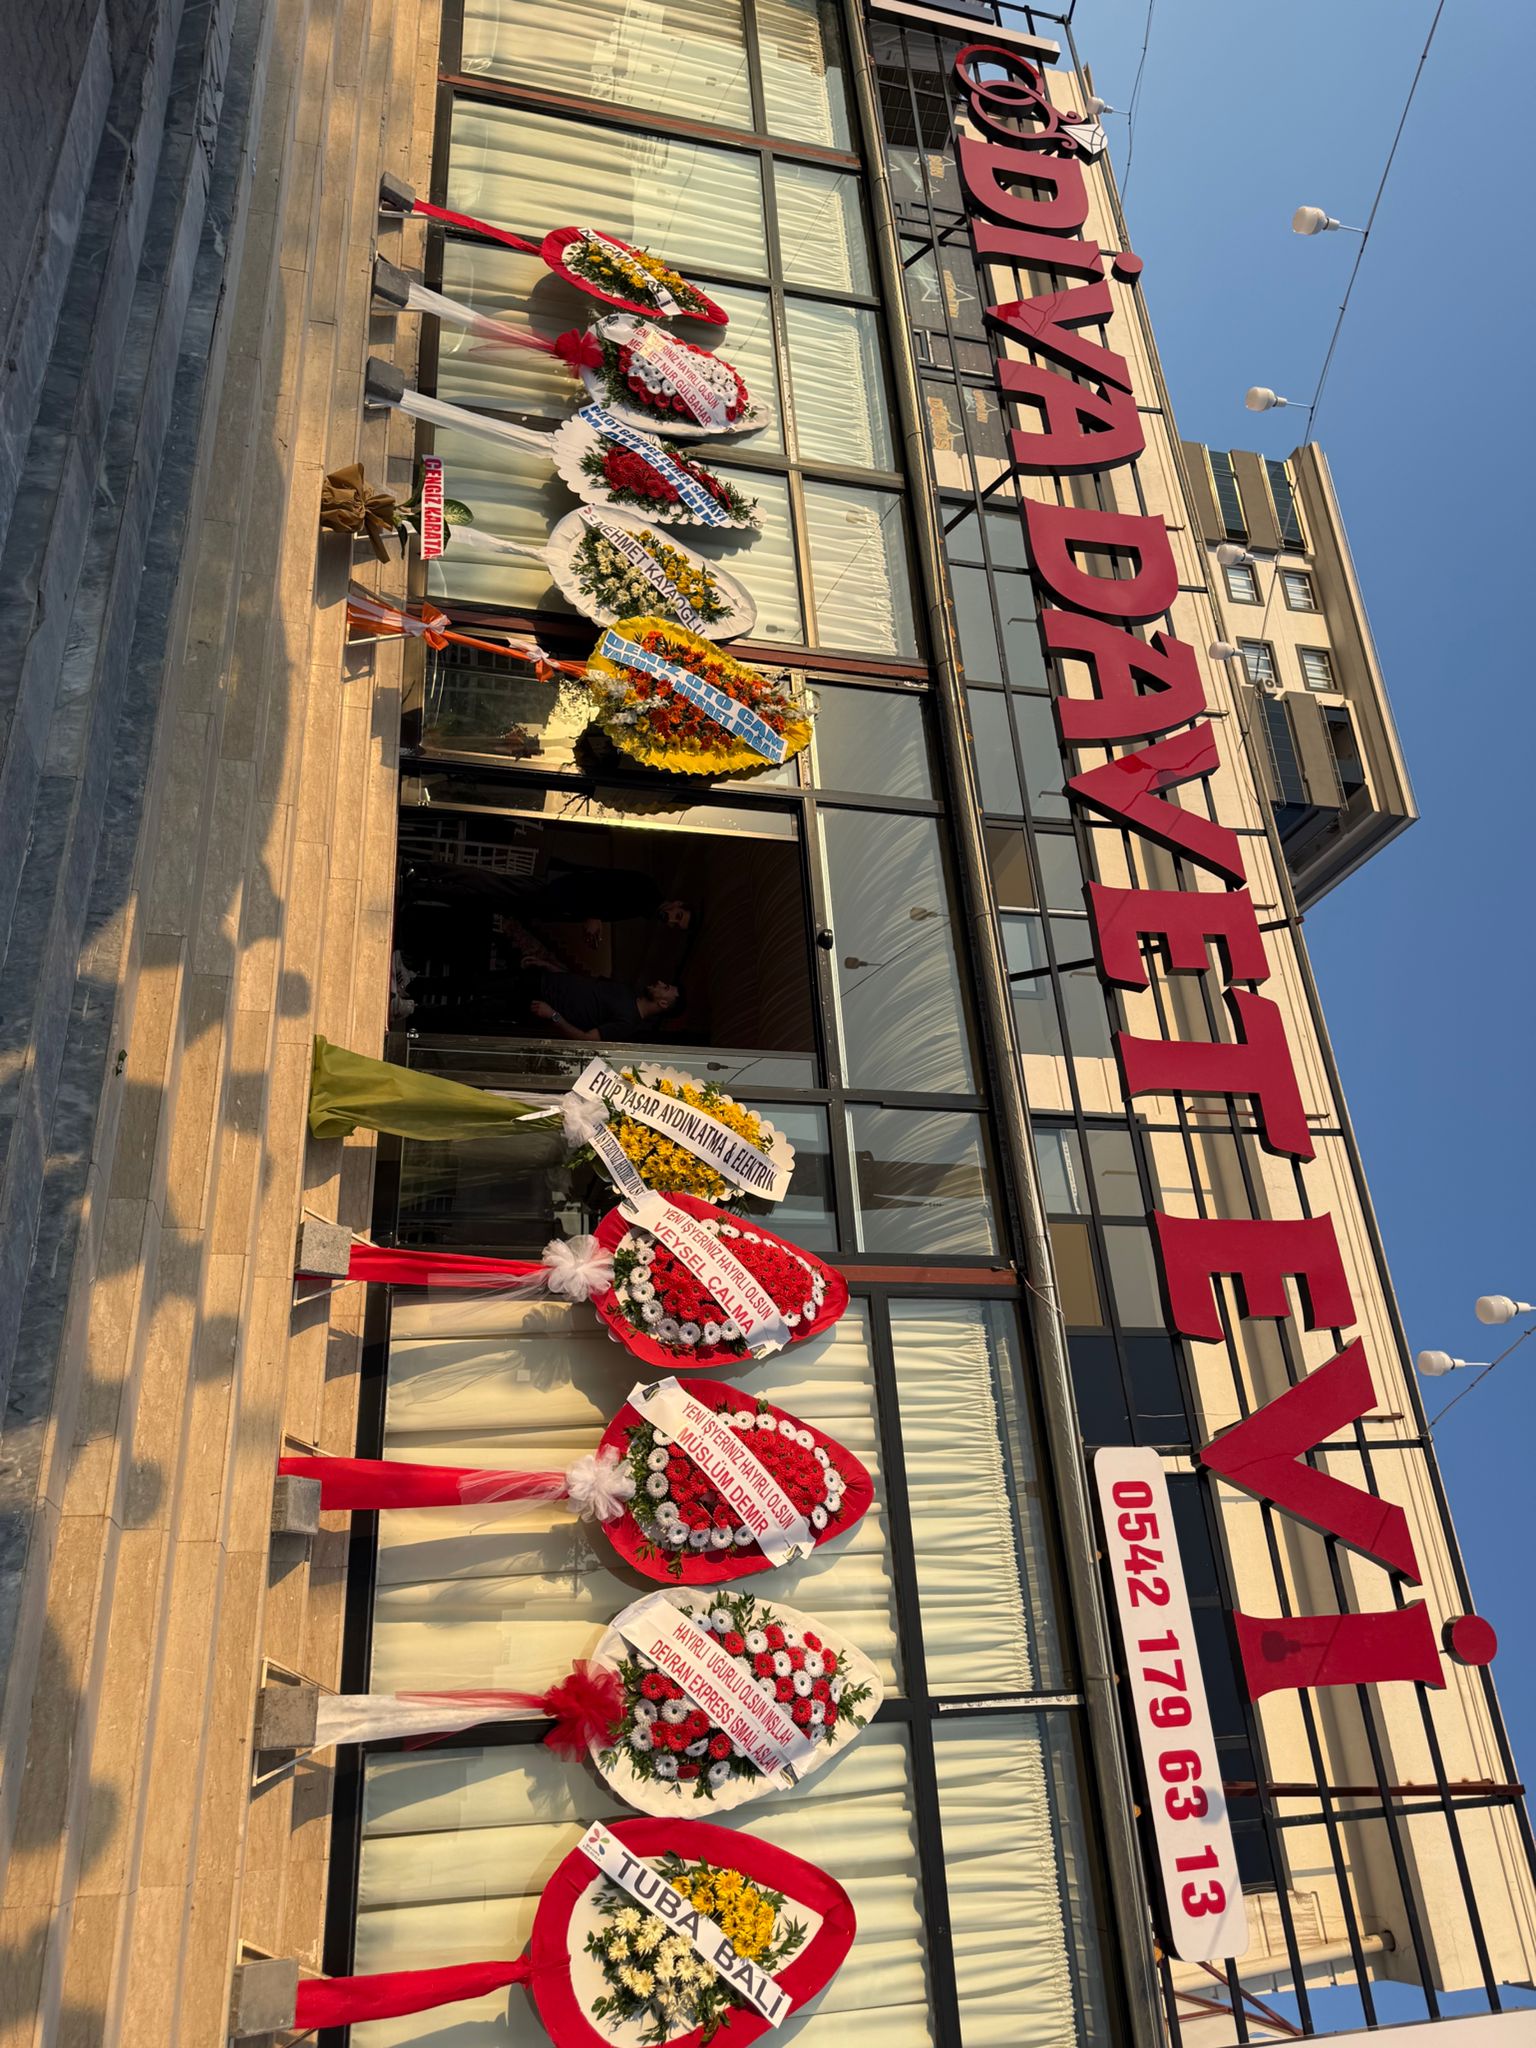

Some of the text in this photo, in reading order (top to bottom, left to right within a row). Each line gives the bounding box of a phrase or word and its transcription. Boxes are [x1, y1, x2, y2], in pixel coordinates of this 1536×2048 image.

[580, 230, 635, 266] NECM
[656, 363, 677, 382] NUR
[675, 379, 713, 427] GÜLBAHAR
[675, 362, 701, 386] HAYIRLI
[698, 385, 720, 410] OLSUN
[619, 428, 664, 458] GARAGE
[659, 457, 694, 486] EVREN
[593, 521, 650, 565] MEHMET
[601, 644, 659, 674] YAKUP
[673, 679, 734, 727] NUSRET
[685, 674, 735, 711] OTO
[737, 707, 785, 750] CAM
[957, 135, 1498, 1703] DİVA DAVET EVİ
[588, 1070, 778, 1192] EYÜP YAŞAR AYDINLATMA & ELEKTRİK
[653, 1222, 755, 1335] VEYSEL ÇALMA
[662, 1208, 773, 1321] YENİ İŞYERİNİZ HAYIRLI OLSUN
[676, 1426, 770, 1537] MÜSLÜM DEMİR
[681, 1402, 796, 1531] YENİ İŞYERİNİZ HAYIRLI OLSUN
[648, 1639, 782, 1774] DEVRAN EXPRESS İSMAİL ASLAN
[672, 1622, 710, 1659] HAYIRLI
[706, 1652, 743, 1693] UĞURLU
[738, 1684, 771, 1717] OLSUN
[1112, 1481, 1227, 1918] 0542 179 63 13
[617, 1851, 785, 2019] TUBA BALİ
